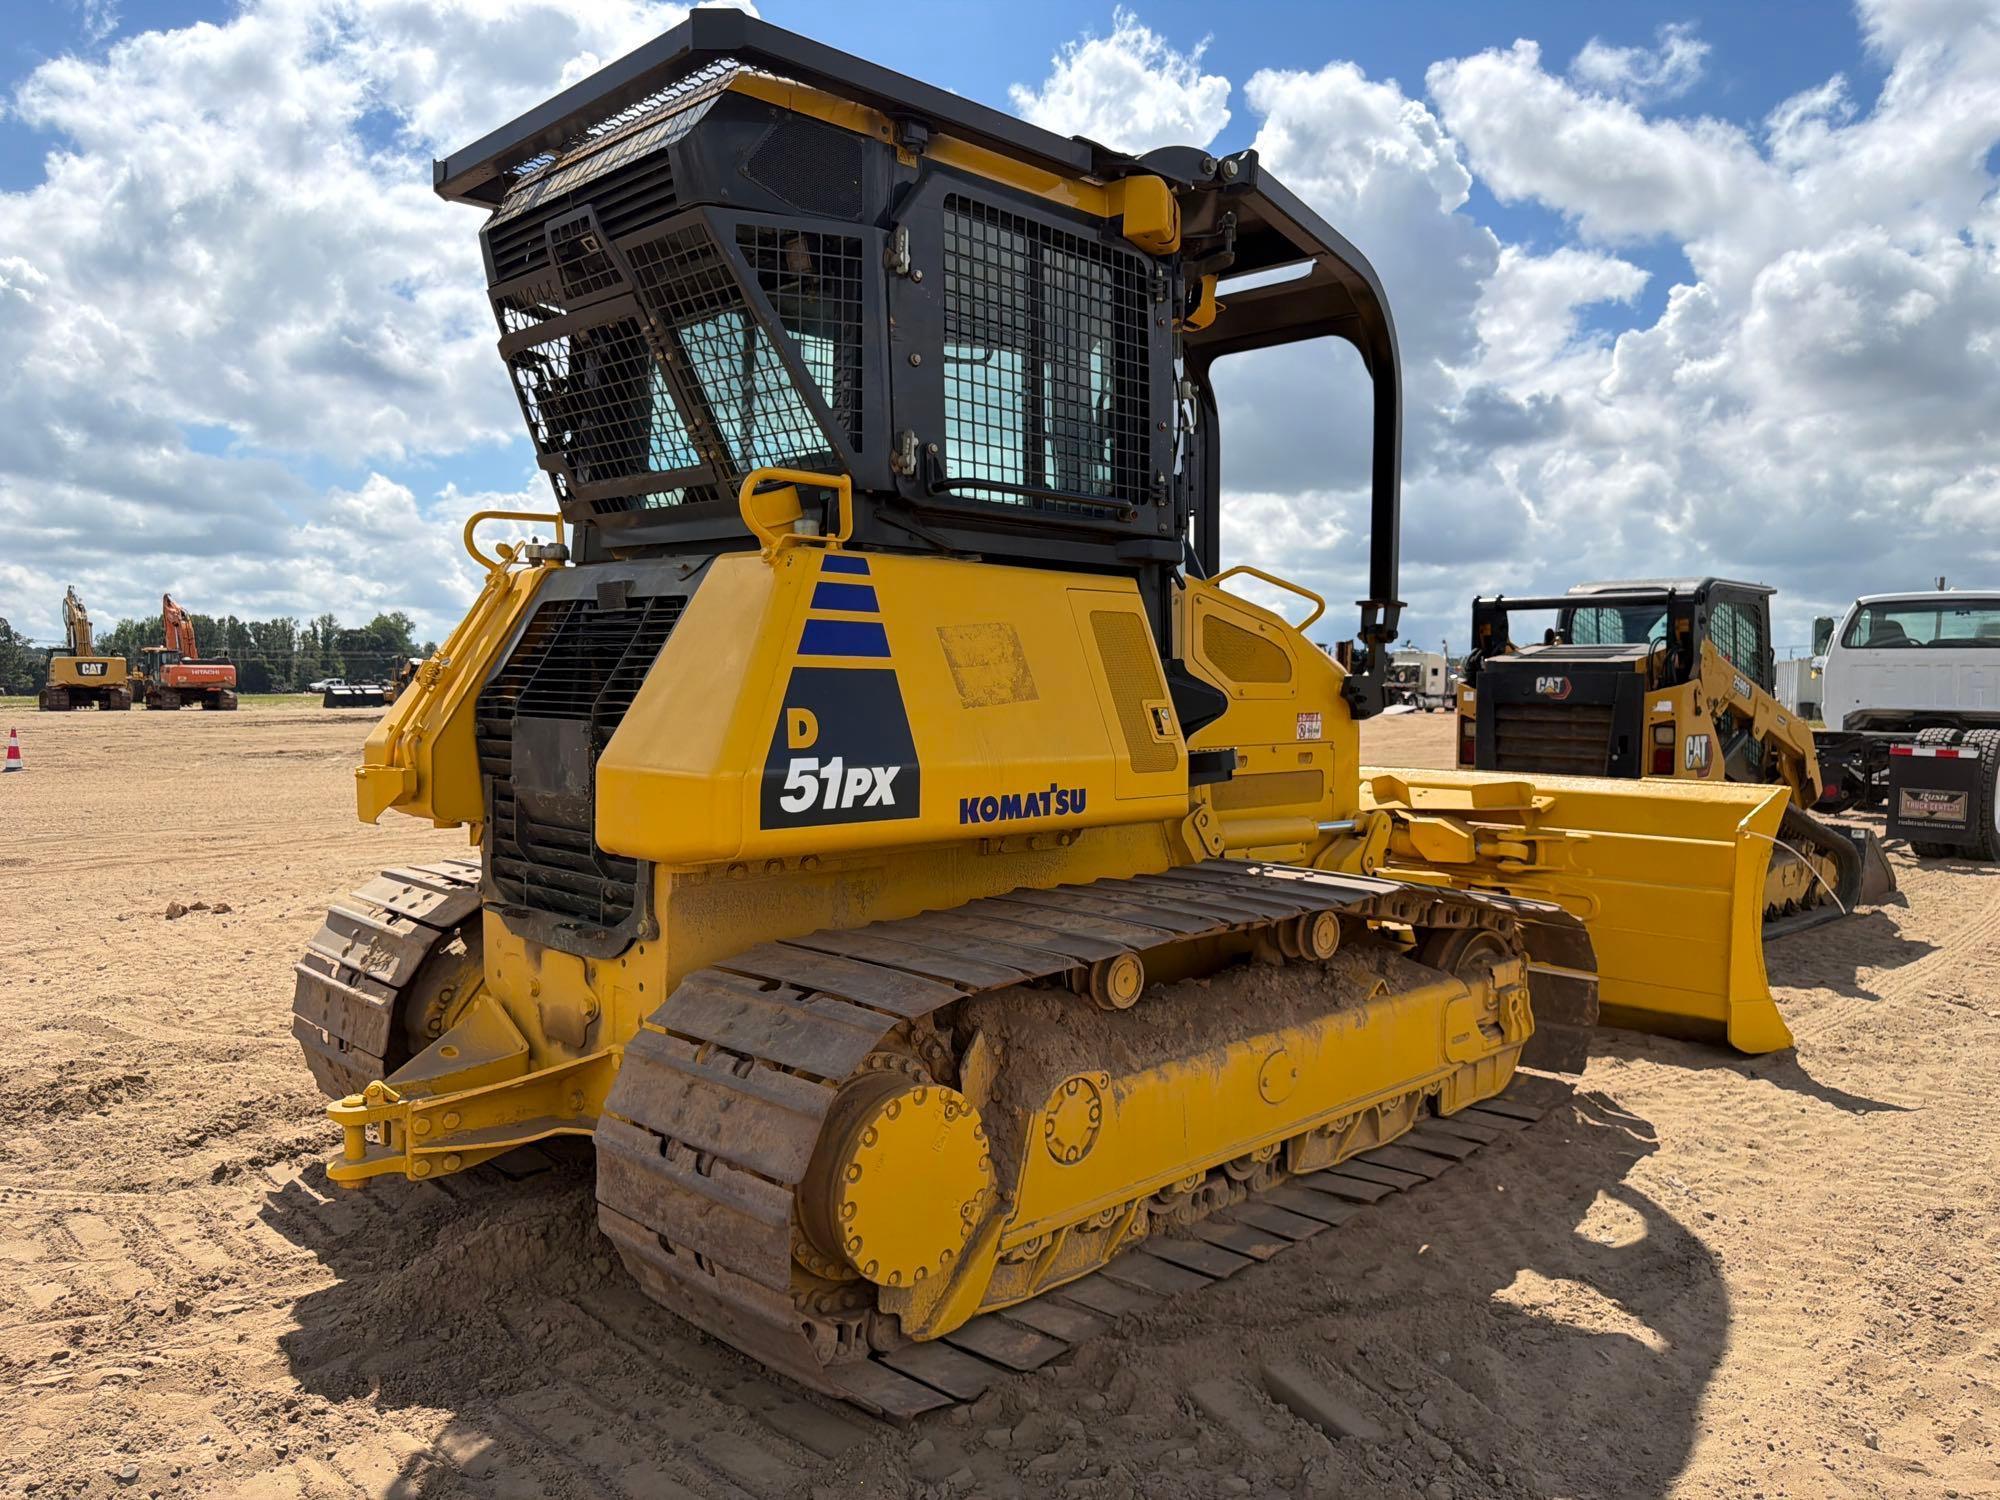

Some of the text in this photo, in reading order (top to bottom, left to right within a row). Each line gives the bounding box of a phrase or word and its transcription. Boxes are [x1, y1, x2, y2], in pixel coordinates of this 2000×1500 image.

[82, 663, 103, 675] CAT
[1535, 676, 1564, 694] CAT
[786, 707, 819, 749] D
[1685, 735, 1709, 769] CAT
[779, 756, 902, 813] 51PX
[959, 782, 1087, 825] KOMATSU
